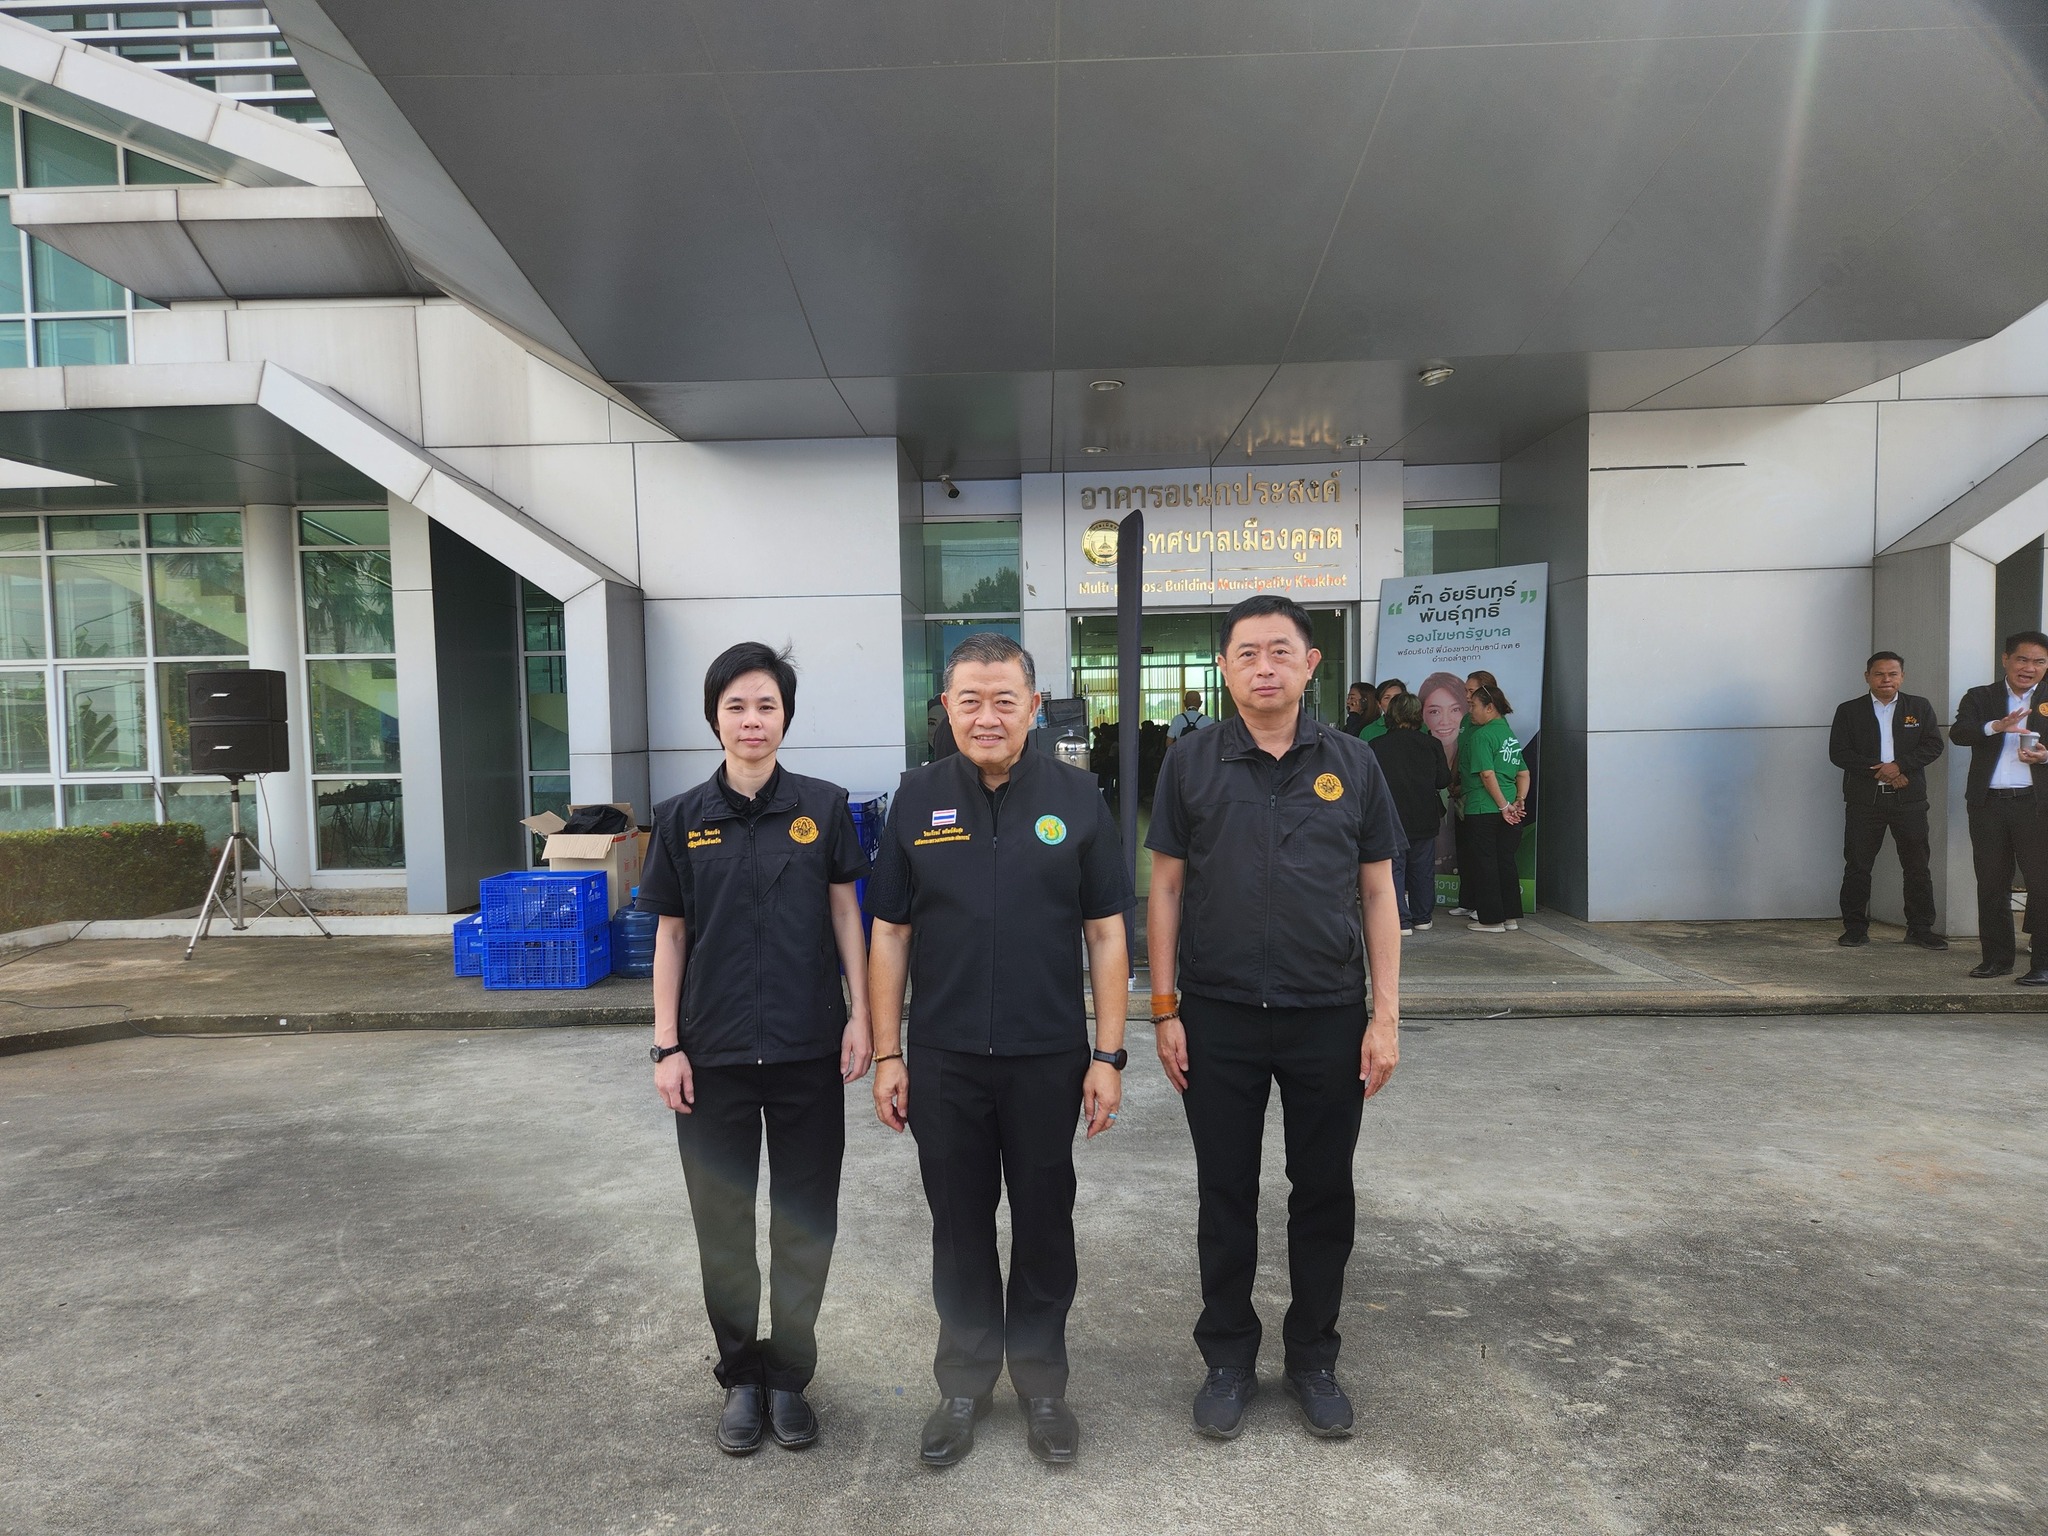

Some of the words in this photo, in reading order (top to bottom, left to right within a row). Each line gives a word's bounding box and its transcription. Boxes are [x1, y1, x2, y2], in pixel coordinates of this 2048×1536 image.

[1080, 469, 1342, 510] อาคารอเนกประสงค์
[1142, 517, 1342, 563] ทศบาลเมืองคูคต
[1165, 578, 1214, 594] Building
[1217, 576, 1292, 593] Municipality
[1294, 573, 1347, 588] Khukhot
[1439, 580, 1517, 603] อัยรินทร์
[1420, 598, 1501, 626] พันธุ์ฤทธิ์
[1407, 627, 1511, 643] รองโฆษกรัฐบาล
